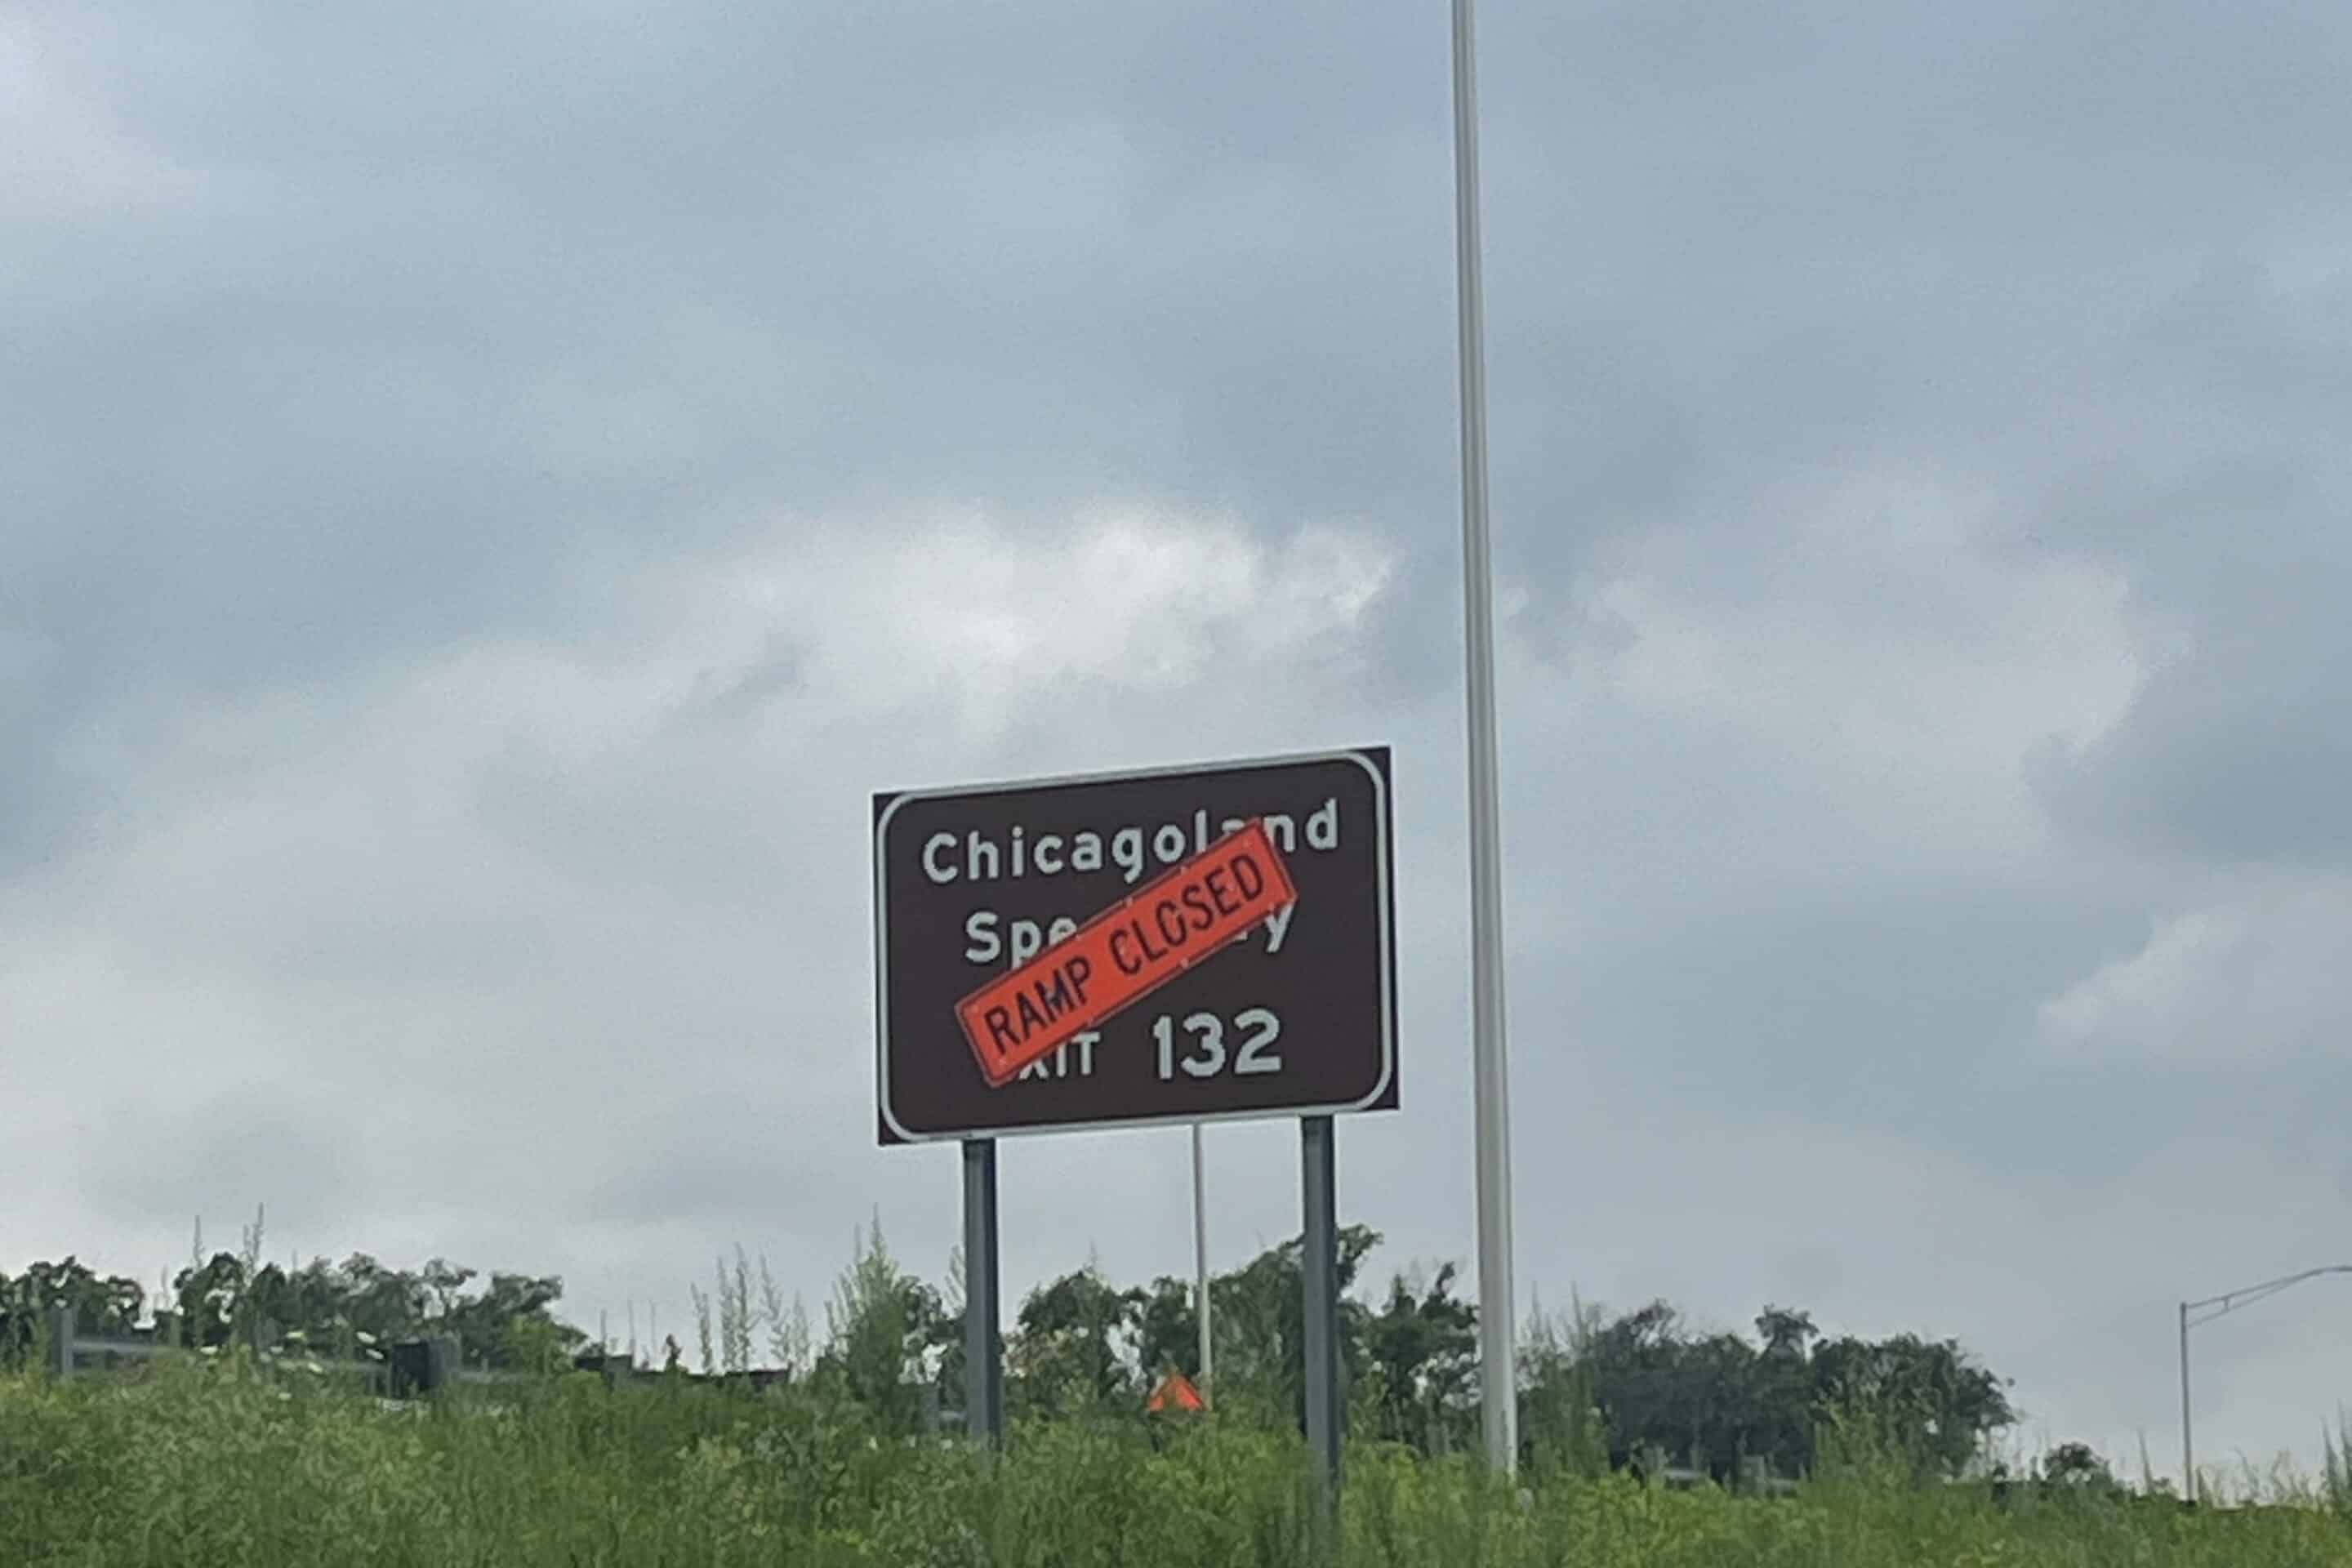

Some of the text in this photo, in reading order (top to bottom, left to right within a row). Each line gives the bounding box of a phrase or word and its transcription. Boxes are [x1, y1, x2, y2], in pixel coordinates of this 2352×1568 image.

[964, 902, 1295, 970] Spey
[984, 854, 1263, 1055] RAMP CLOSED
[1152, 1007, 1282, 1079] 132
